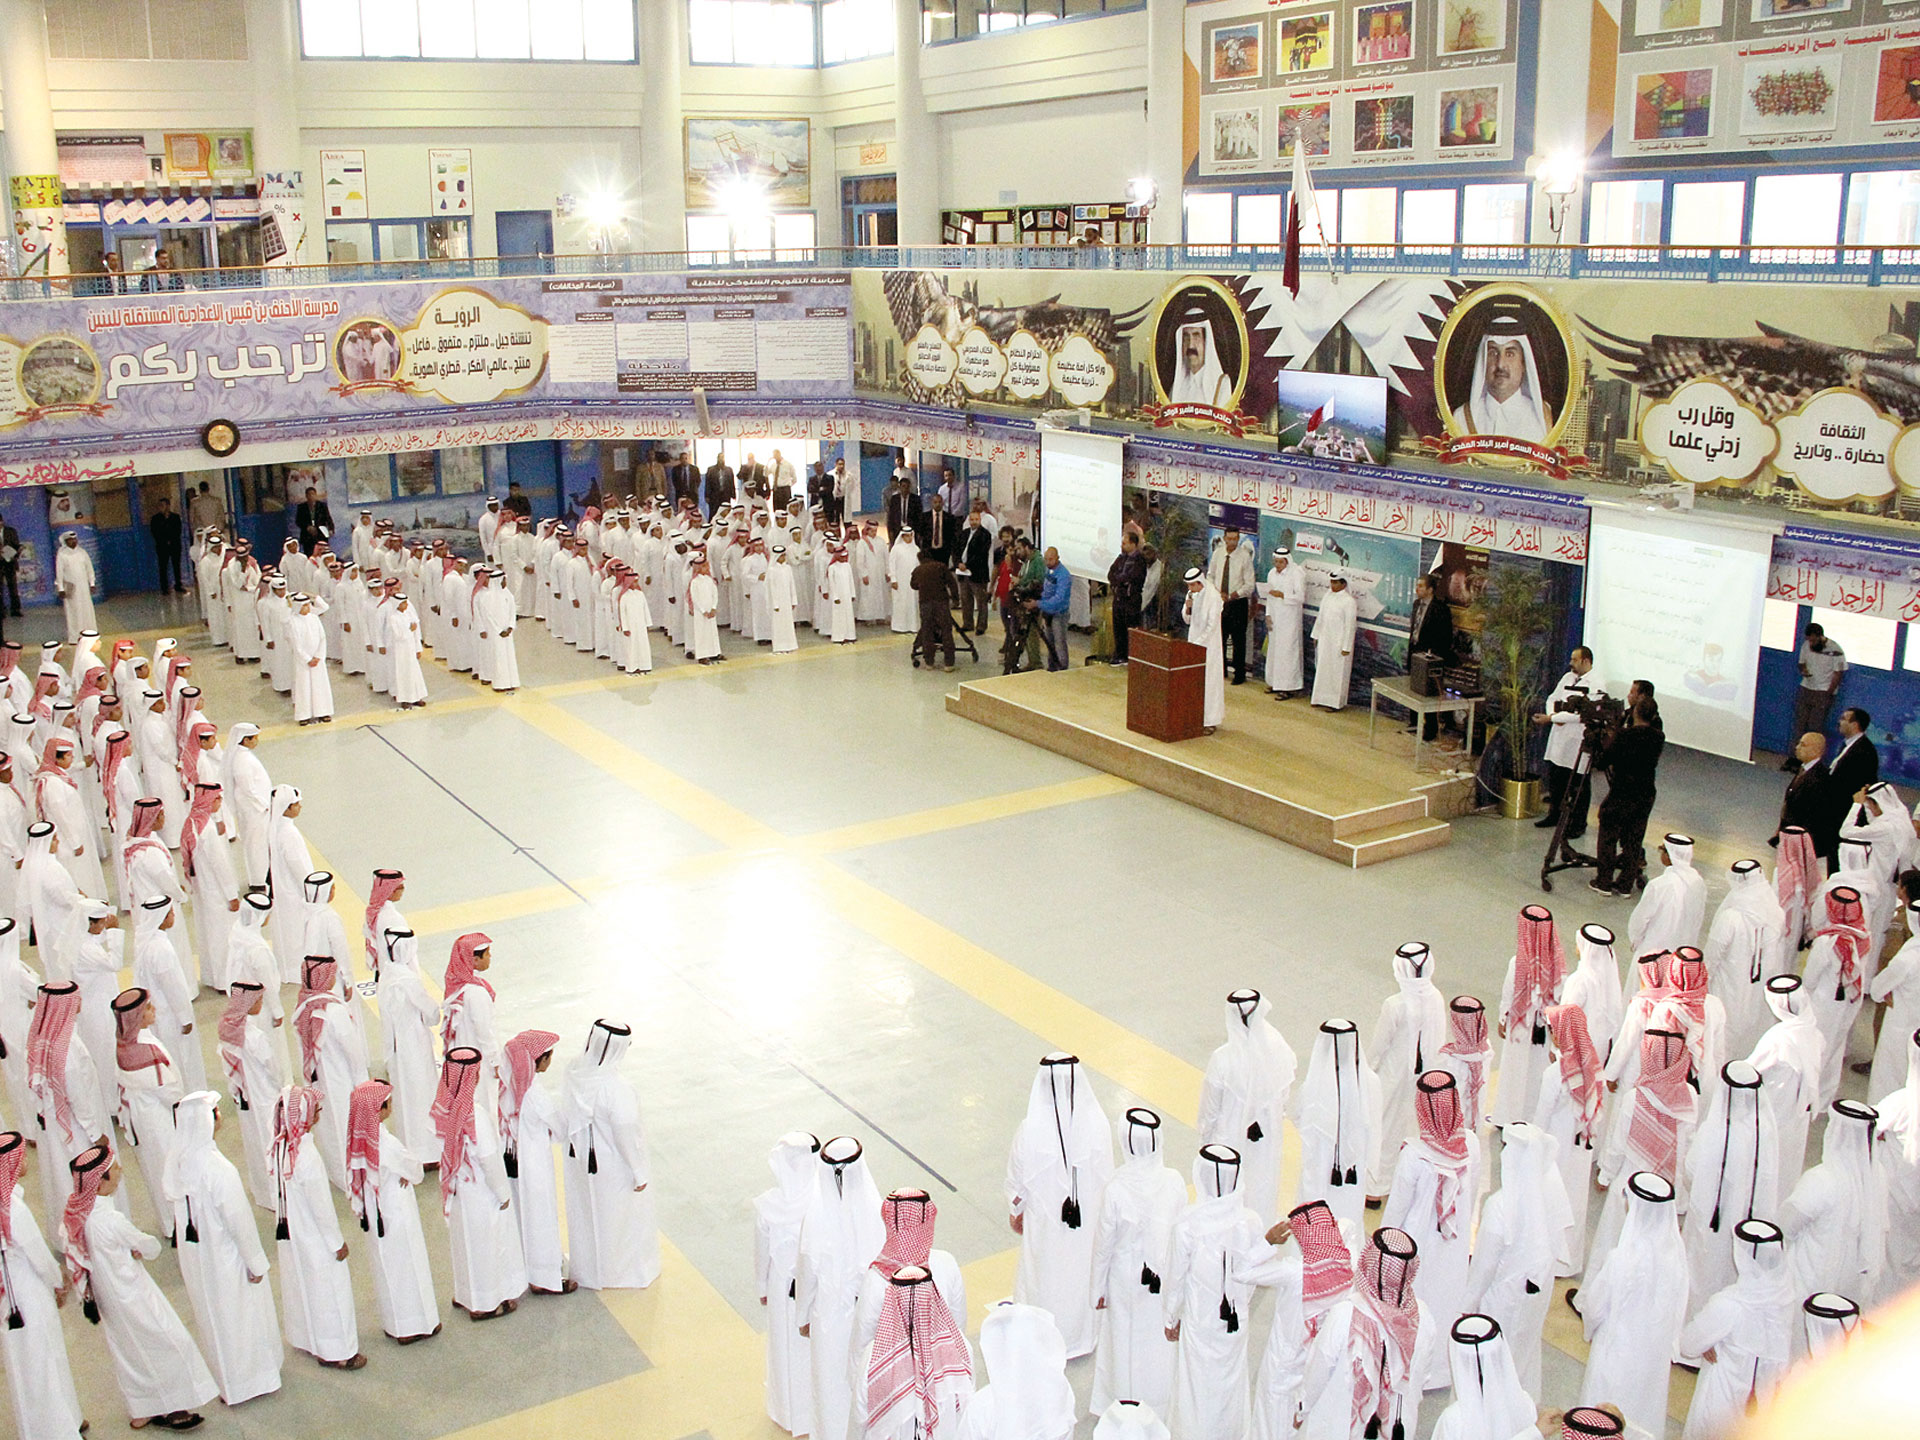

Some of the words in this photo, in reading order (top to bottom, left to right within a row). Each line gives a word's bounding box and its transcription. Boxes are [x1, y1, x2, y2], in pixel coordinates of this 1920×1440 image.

[1813, 39, 1837, 52] مع
[1844, 28, 1890, 46] الفنية
[1738, 38, 1810, 56] الرياضيات
[1481, 54, 1501, 64] الجهاد
[37, 192, 46, 204] 5
[691, 279, 725, 287] للطلبة
[771, 278, 809, 286] التقويم
[225, 301, 253, 325] قيس
[255, 304, 267, 324] بن
[269, 294, 303, 318] الأحنف
[304, 297, 339, 316] مدرسة
[88, 308, 121, 332] للبنين
[124, 305, 176, 327] المستقلة
[412, 337, 431, 354] فاعل
[437, 335, 462, 353] متفوق
[469, 334, 489, 352] ملتزم
[496, 333, 510, 350] جيل
[510, 331, 532, 346] تنشئة
[207, 332, 328, 389] ترحب
[1009, 349, 1026, 359] النظام
[1026, 350, 1042, 360] احترام
[105, 342, 199, 400] بكم
[413, 362, 439, 379] الهوية
[440, 360, 461, 380] قطري
[468, 358, 486, 375] الفكر
[487, 357, 508, 380] عالمي
[514, 355, 531, 375] منتج
[628, 362, 680, 370] ملاحظة
[1010, 361, 1018, 372] كل
[1057, 361, 1075, 372] عظيمة
[1086, 363, 1095, 374] كل
[1022, 376, 1040, 387] مواطن
[1062, 375, 1081, 387] عظيمة
[1082, 377, 1095, 387] تربية
[1163, 407, 1178, 417] الوالد
[1194, 408, 1213, 416] السمو
[1213, 412, 1233, 424] صاحب
[1678, 406, 1699, 427] رب
[1702, 404, 1734, 430] وقل
[444, 429, 465, 446] سيدنا
[465, 427, 480, 444] على
[613, 421, 625, 438] ذو
[633, 420, 659, 438] الملك
[660, 420, 686, 438] مالك
[736, 420, 773, 439] الرشيد
[781, 419, 813, 440] الوارث
[821, 418, 850, 440] الباقي
[1819, 422, 1866, 441] الثقافة
[404, 432, 424, 451] وعلى
[423, 430, 442, 447] محمد
[1476, 440, 1494, 448] البلاد
[1494, 440, 1509, 449] أمير
[1668, 429, 1702, 451] علما
[1509, 443, 1532, 454] السمو
[1532, 450, 1556, 465] صاحب
[1705, 434, 1740, 463] زدني
[1793, 441, 1832, 462] وتاريخ
[1844, 446, 1885, 465] حضارة
[1146, 466, 1170, 489] المنتقم
[1176, 468, 1202, 496] التواب
[1207, 475, 1225, 498] البر
[1230, 478, 1261, 505] المتعال
[1267, 484, 1293, 512] الوالي
[1299, 491, 1333, 517] الباطن
[1340, 498, 1376, 523] الظاهر
[1519, 507, 1548, 521] المستقلة
[1506, 521, 1542, 553] المقدم
[1820, 558, 1830, 568] بن
[1868, 563, 1902, 577] مدرسة
[1767, 566, 1819, 601] الماجد
[1830, 574, 1886, 614] الواجد
